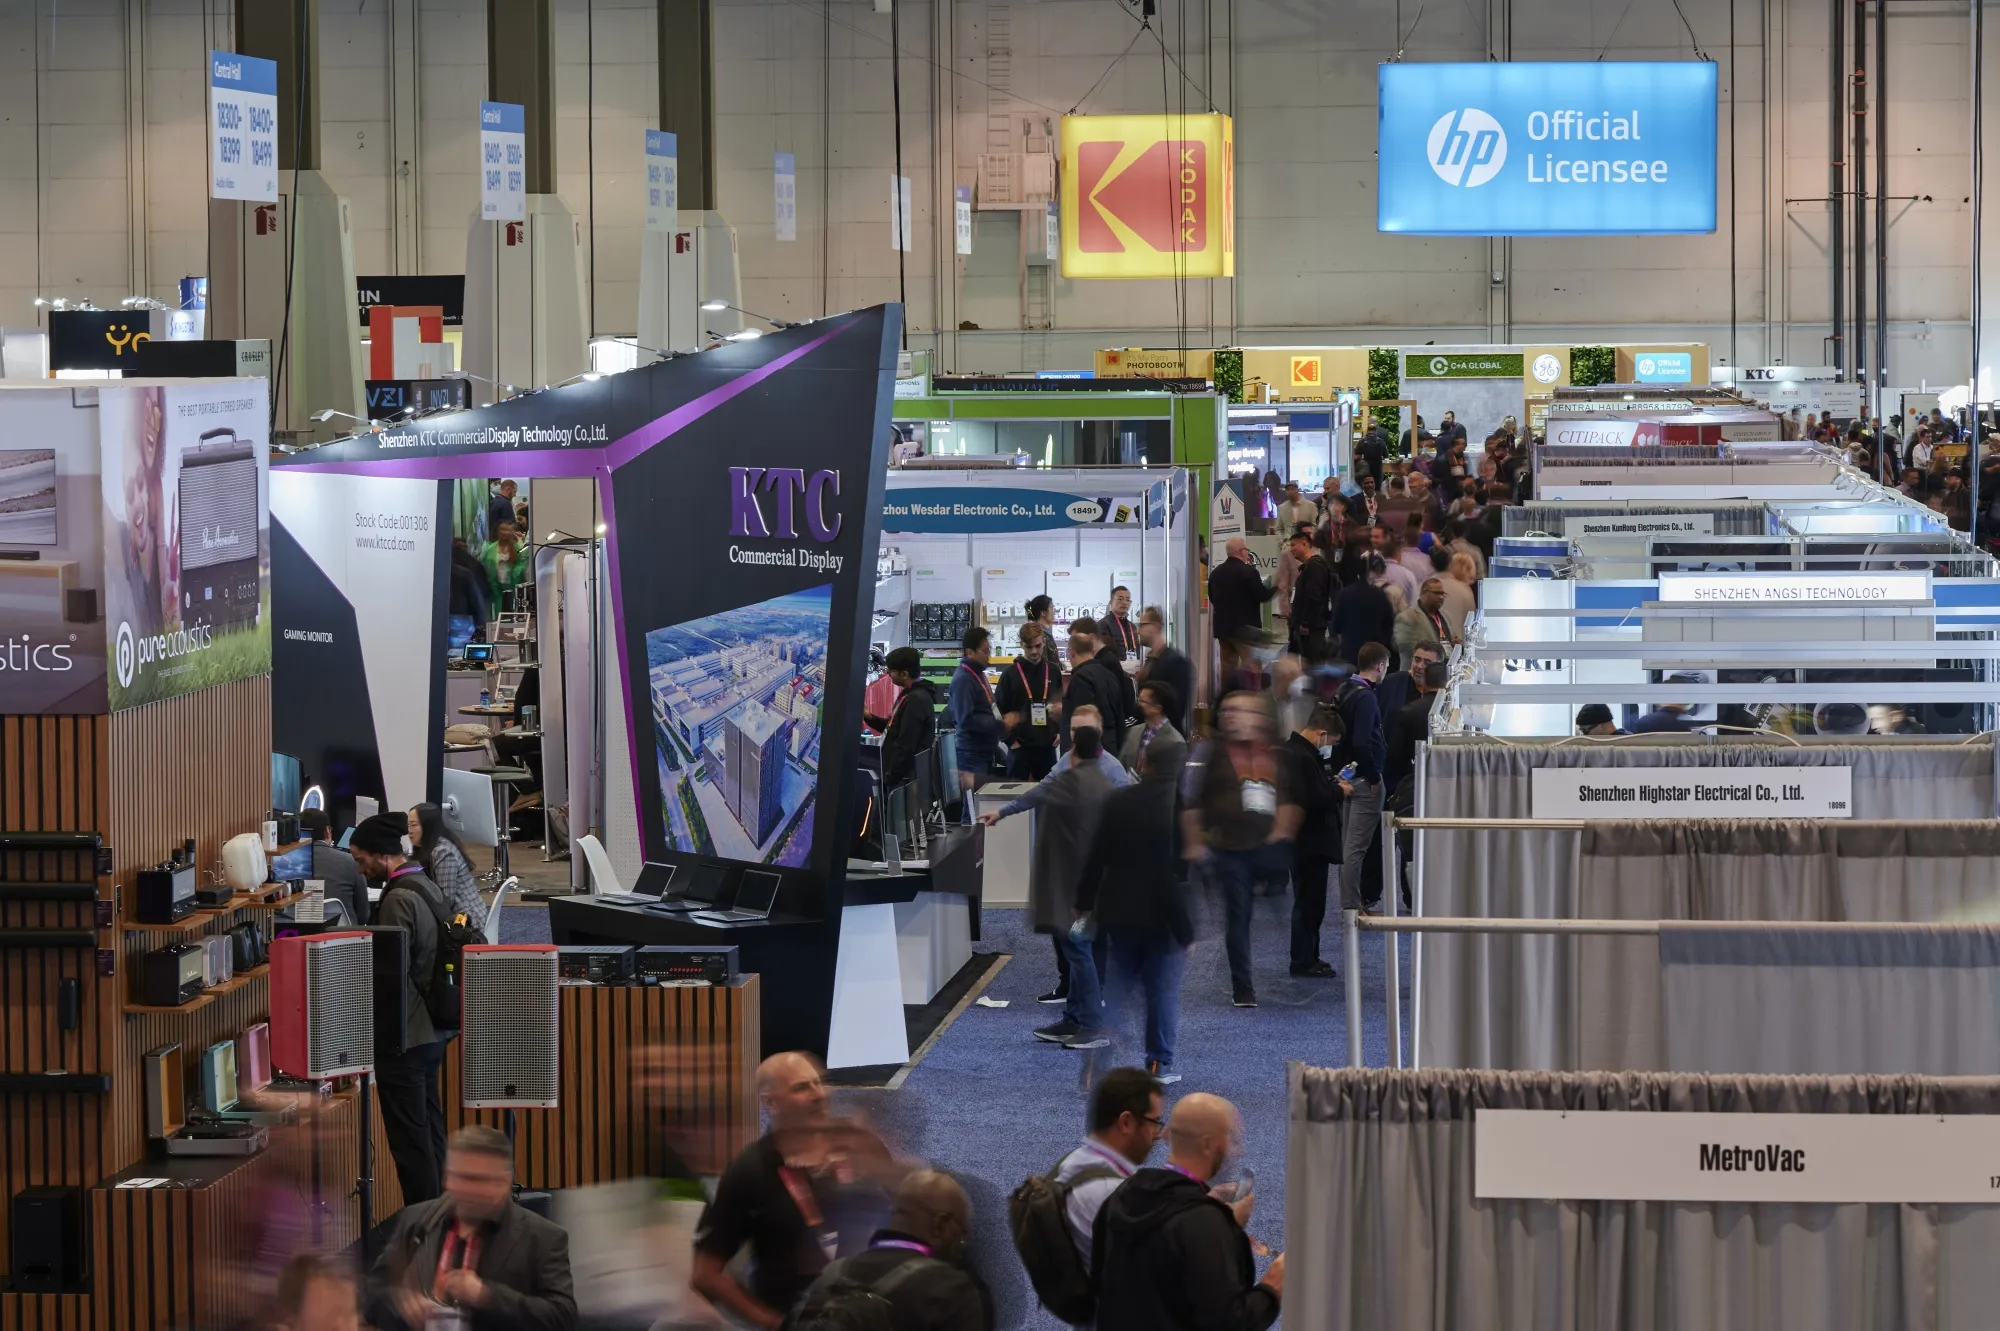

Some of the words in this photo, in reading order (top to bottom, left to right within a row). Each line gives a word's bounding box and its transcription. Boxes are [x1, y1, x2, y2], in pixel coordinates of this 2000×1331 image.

[215, 61, 231, 77] Central
[231, 63, 242, 80] Hall
[217, 102, 242, 130] 18300-
[249, 106, 273, 134] 18400-
[483, 109, 495, 123] Central
[1527, 110, 1640, 141] Official
[220, 137, 241, 163] 18399
[252, 140, 272, 166] 18499
[1430, 108, 1504, 187] hp
[1527, 153, 1668, 183] Licensee
[1180, 148, 1197, 243] KODAK
[356, 290, 380, 303] IN
[241, 350, 264, 361] CROSLEY
[1138, 355, 1149, 363] My
[1150, 355, 1169, 363] Party
[1657, 359, 1681, 367] Official
[1657, 367, 1687, 375] Licensee
[1745, 369, 1775, 380] KTC
[187, 404, 198, 416] BEST
[199, 402, 219, 415] PORTABLE
[220, 401, 235, 413] STEREO
[236, 399, 253, 411] SPEAKER
[431, 389, 449, 408] INVZI
[1551, 404, 1595, 412] CENTRAL
[378, 432, 418, 448] Shenzhen
[420, 431, 436, 446] KTC
[438, 428, 487, 445] Commercial
[488, 426, 520, 447] Display
[522, 426, 572, 446] Technology
[574, 424, 608, 443] Co.,Ltd.
[1558, 430, 1624, 444] CITIPACK
[728, 466, 842, 542] KTC
[883, 504, 908, 515] zhou
[911, 503, 951, 515] Wesdar
[954, 504, 1008, 515] Electronic
[1012, 503, 1032, 517] Co.,
[1035, 503, 1056, 516] Ltd.
[1072, 507, 1097, 515] 18491
[356, 513, 376, 528] Stock
[378, 514, 428, 531] Code:001308
[1584, 524, 1611, 533] Shenzhen
[1612, 523, 1637, 533] KunHong
[1638, 523, 1670, 532] Electronics
[1671, 523, 1683, 532] Co.,
[1684, 522, 1695, 531] Ltd.
[356, 534, 415, 551] www.ktccd.com
[729, 545, 797, 566] Commercial
[799, 549, 843, 574] Display
[1694, 588, 1760, 600] SHENZHEN
[1764, 588, 1802, 599] ANGSI
[1805, 587, 1888, 599] TECHNOLOGY
[284, 629, 306, 641] GAMING
[307, 630, 334, 643] MONITOR
[138, 636, 166, 674] pure
[167, 621, 212, 659] acoustics
[1579, 785, 1636, 802] Shenzhen
[1639, 785, 1690, 804] Highstar
[1694, 784, 1752, 801] Electrical
[1755, 784, 1779, 803] Co.,
[1782, 784, 1805, 801] Ltd.
[1828, 801, 1846, 810] 18096
[1700, 1143, 1805, 1172] MetroVac
